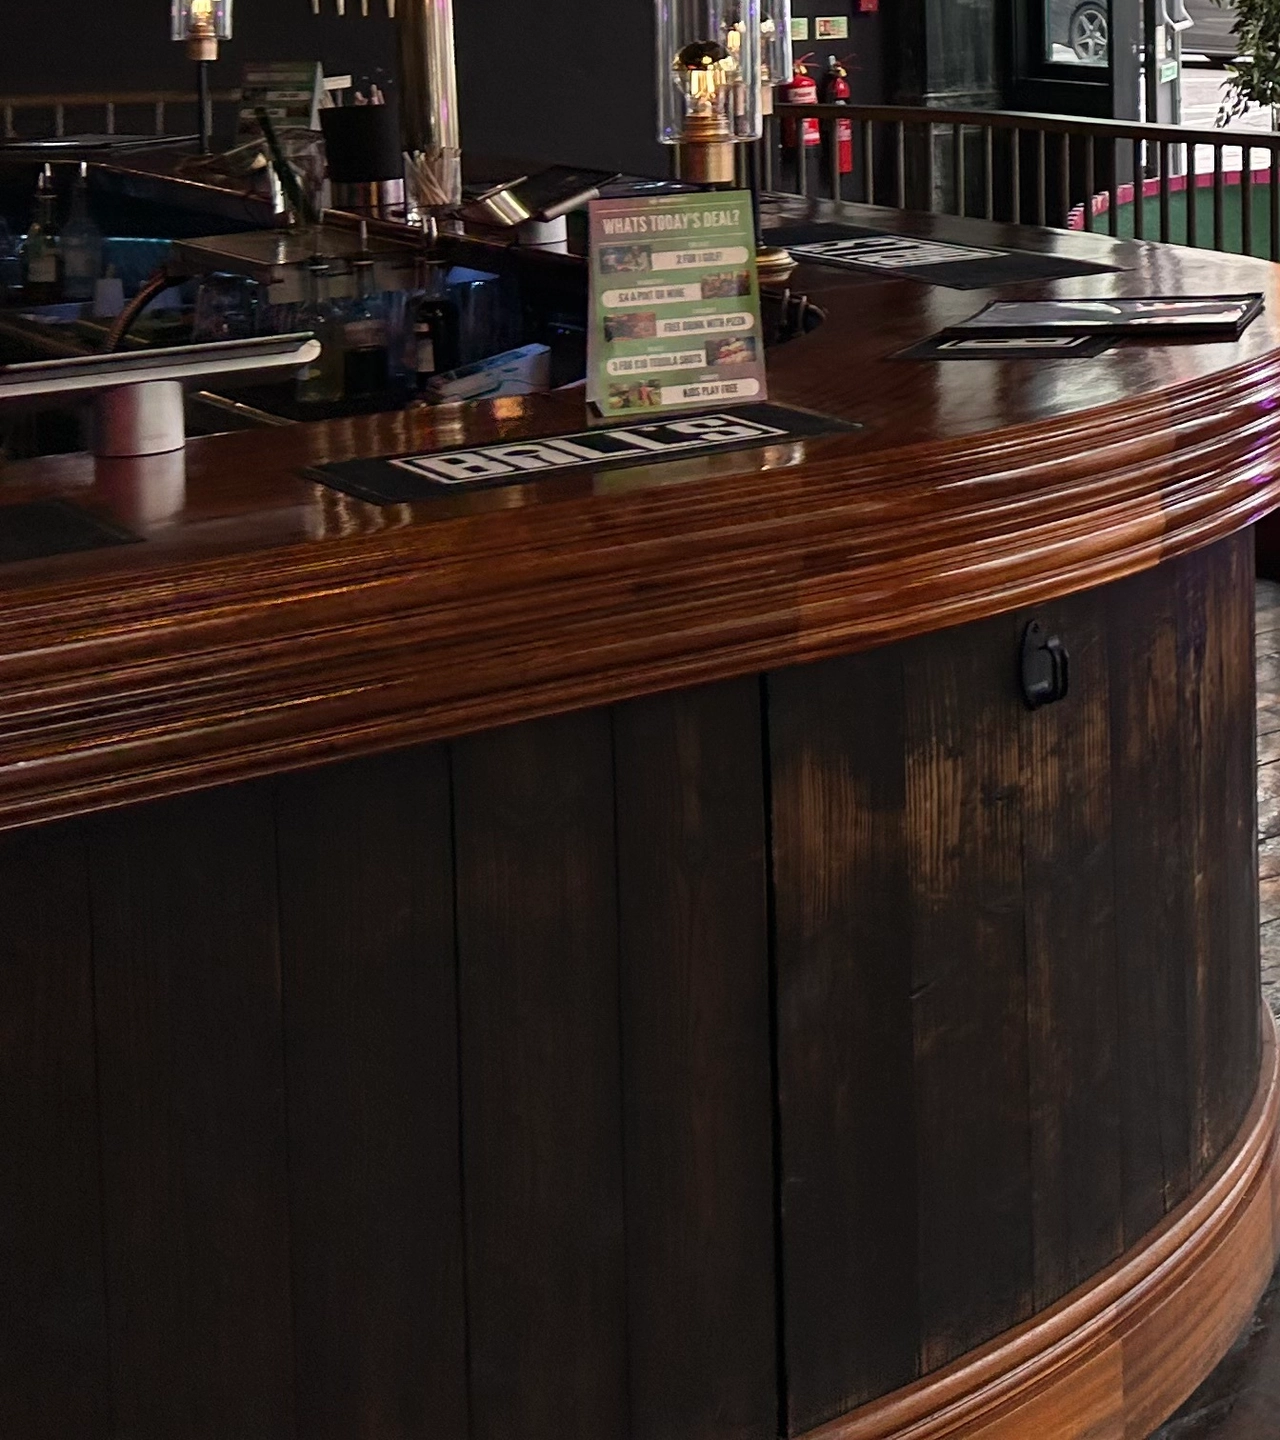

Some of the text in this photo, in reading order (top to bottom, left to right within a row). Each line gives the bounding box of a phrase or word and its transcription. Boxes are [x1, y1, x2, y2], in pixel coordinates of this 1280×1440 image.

[602, 209, 740, 235] WHATS TODAY'S DEAL?
[701, 385, 720, 396] PLAY
